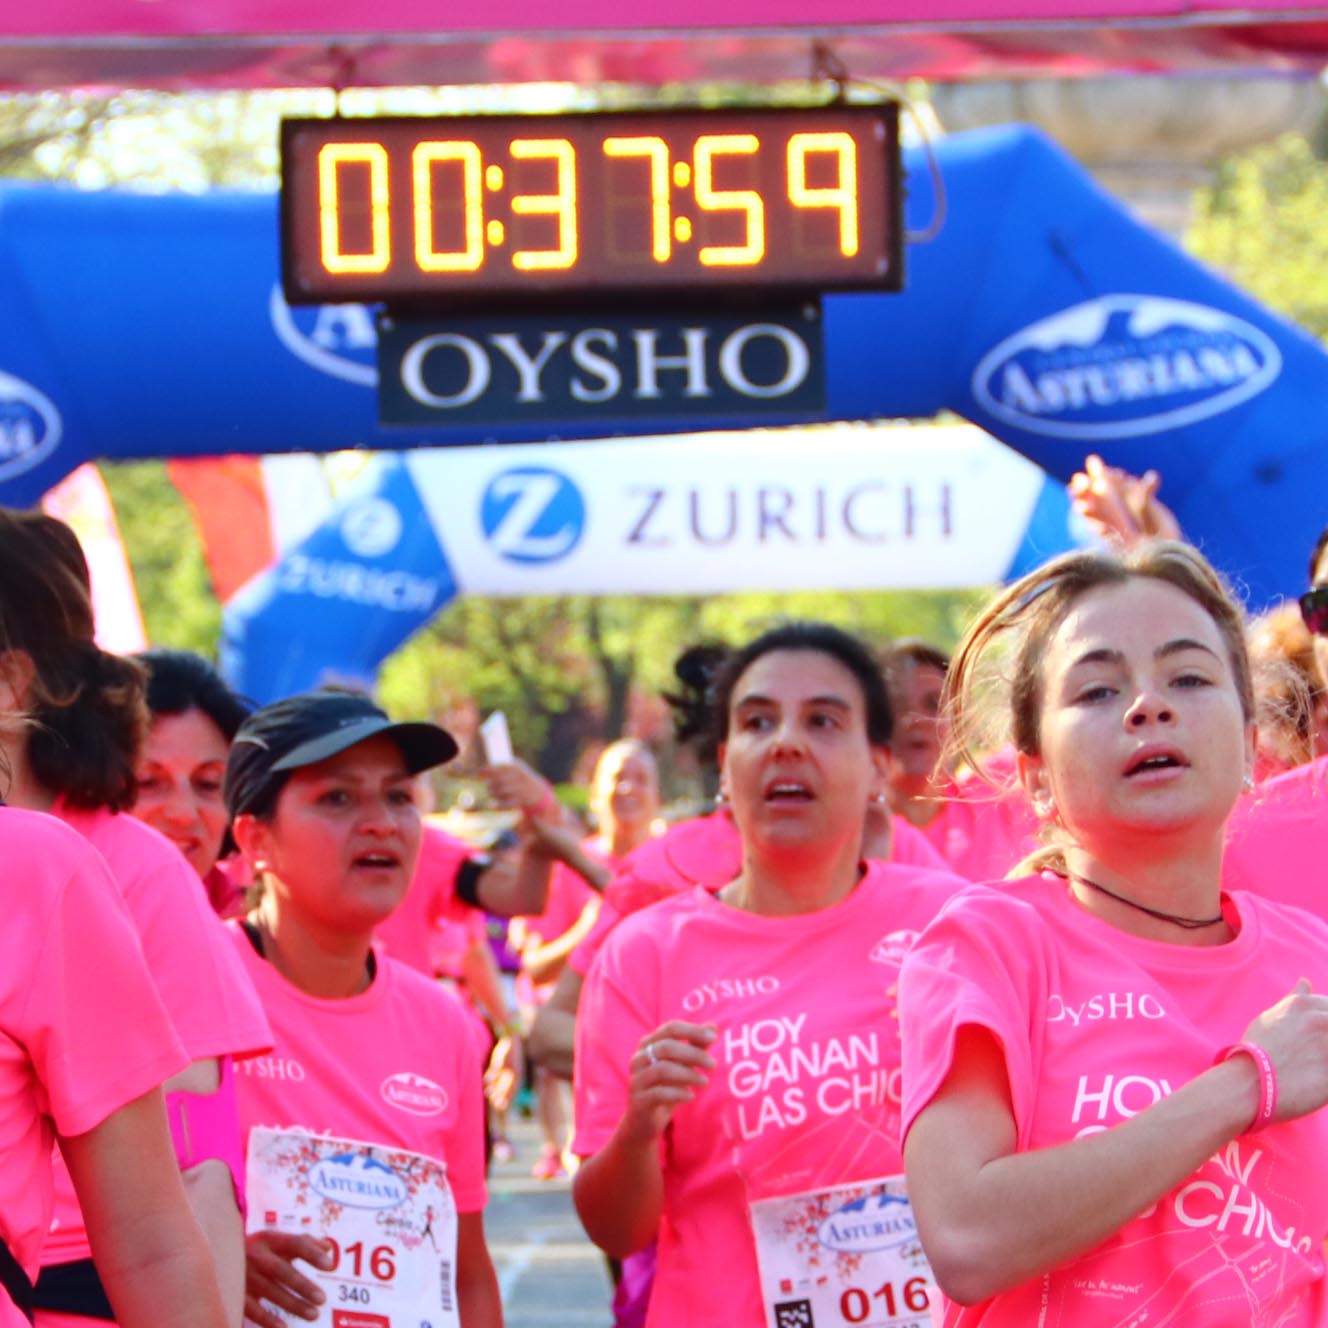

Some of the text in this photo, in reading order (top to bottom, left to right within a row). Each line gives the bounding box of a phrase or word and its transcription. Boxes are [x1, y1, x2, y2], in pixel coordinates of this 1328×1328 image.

[317, 131, 858, 273] 00:37:59
[400, 322, 810, 407] OYSHO
[626, 480, 952, 546] ZURICH
[682, 976, 779, 1012] OYSHO
[725, 1013, 806, 1063] HOY
[728, 1033, 879, 1098] GANAN
[738, 1088, 806, 1140] LAS
[319, 1170, 400, 1199] ASTURIANA
[829, 1218, 914, 1243] ASTURIAN
[338, 1284, 370, 1305] 340
[841, 1277, 929, 1325] 016
